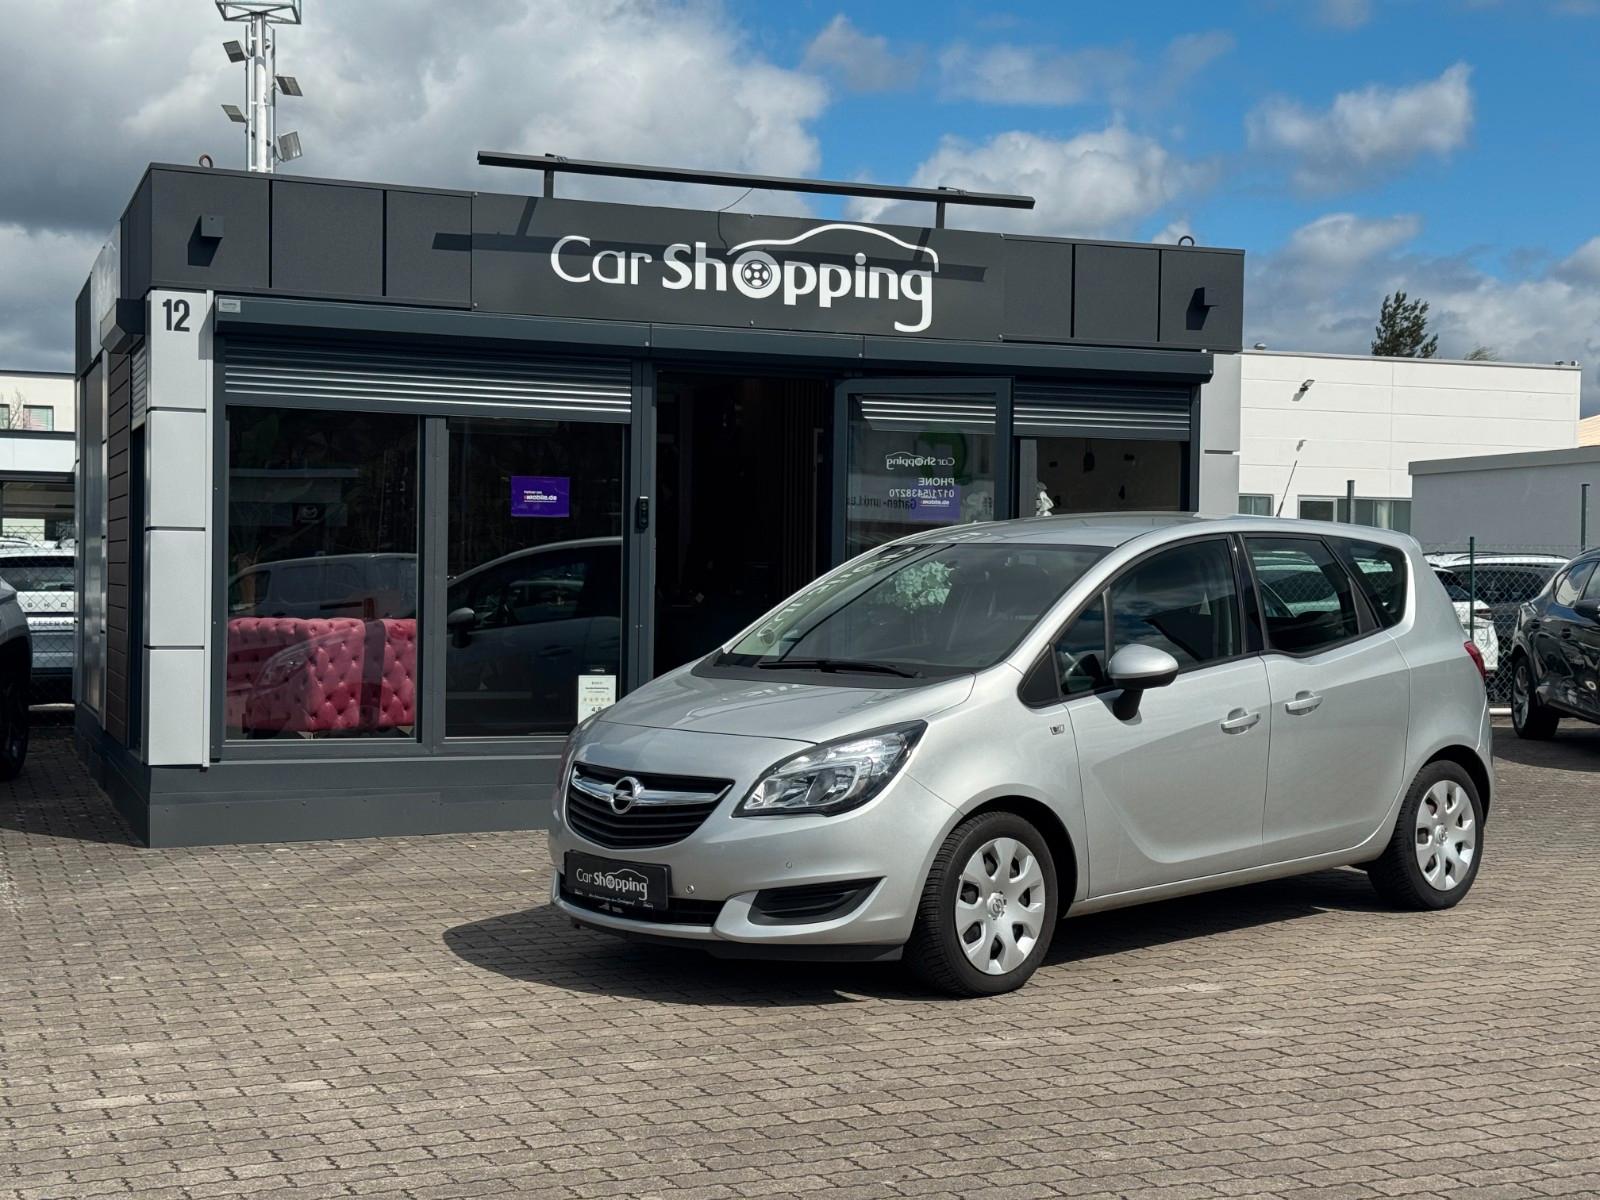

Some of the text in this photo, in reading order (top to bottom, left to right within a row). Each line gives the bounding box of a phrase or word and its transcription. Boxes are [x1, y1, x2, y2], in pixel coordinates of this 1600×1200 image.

[550, 234, 935, 333] Car Shopping
[162, 298, 190, 332] 12
[576, 868, 593, 883] Car
[593, 871, 648, 901] Shopping
